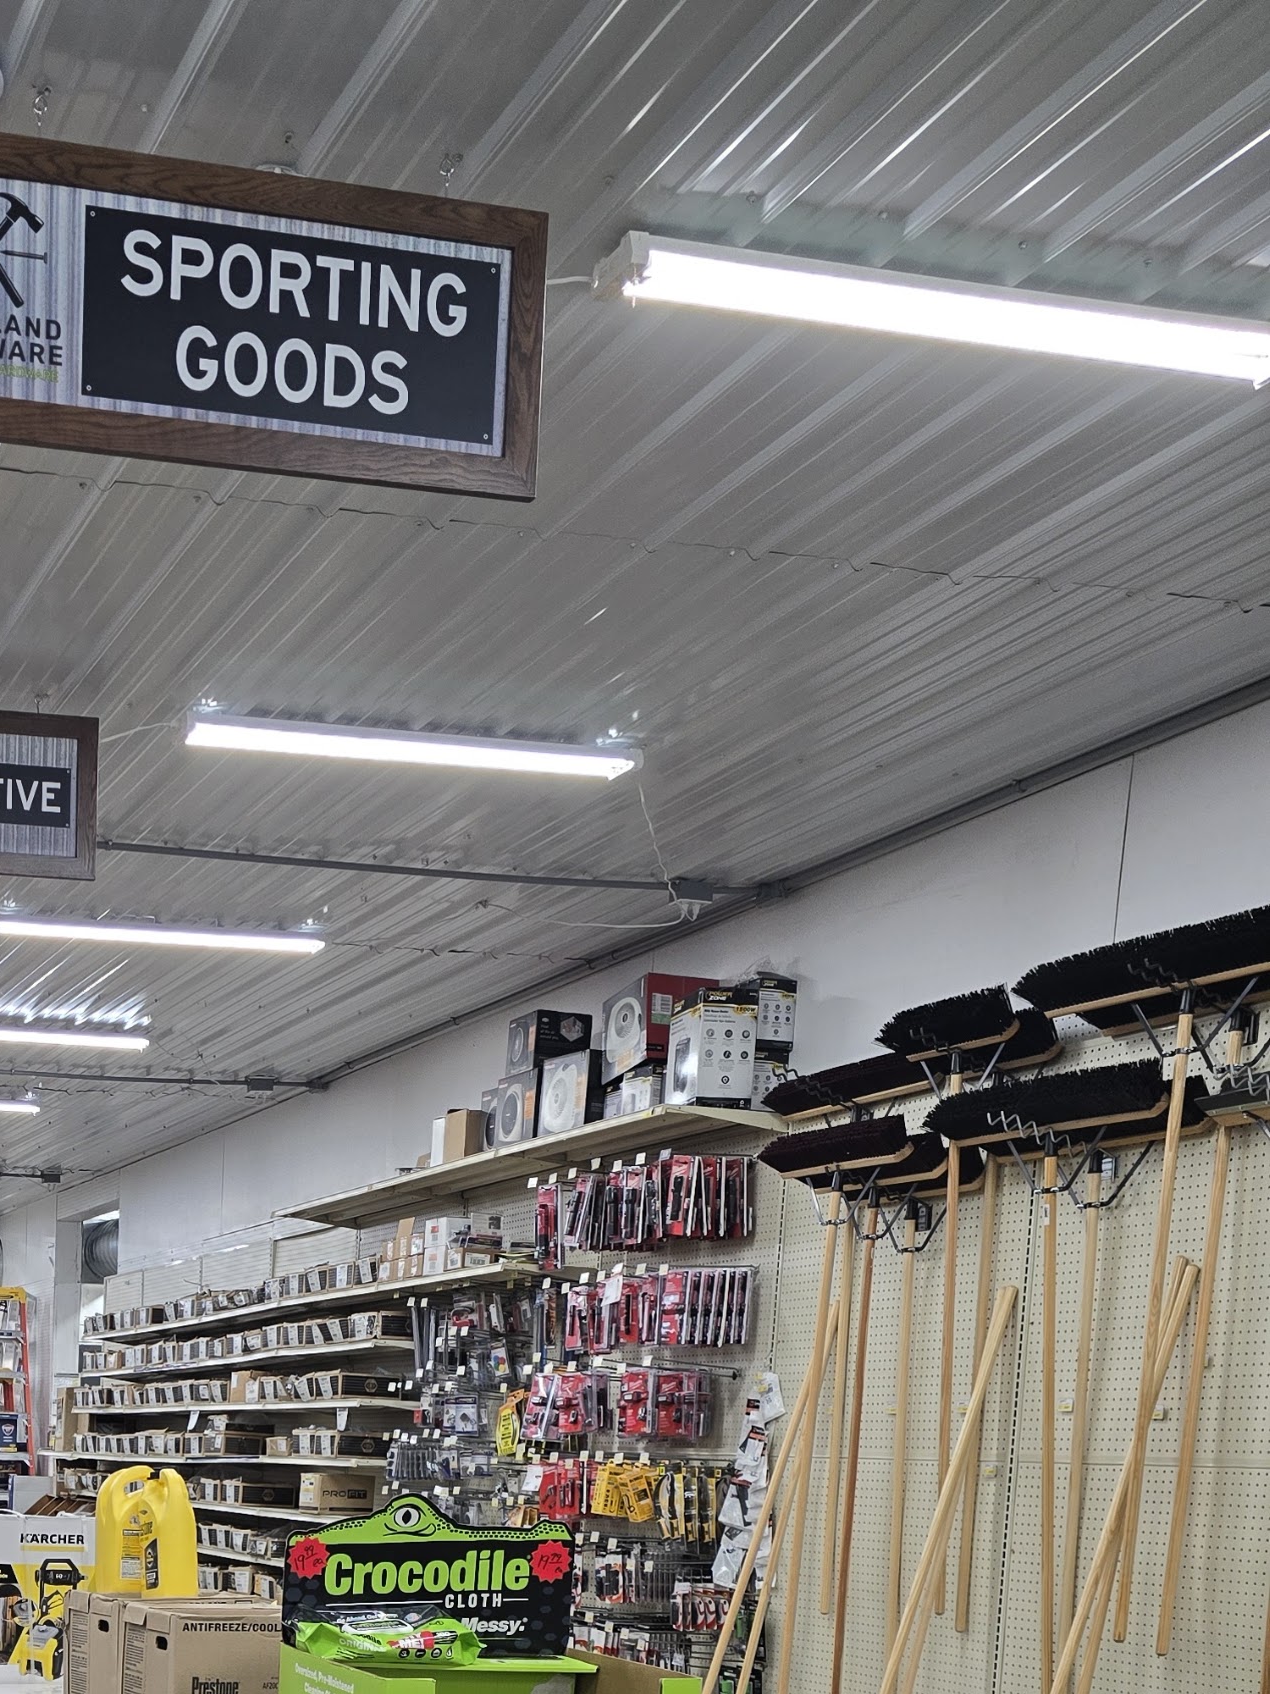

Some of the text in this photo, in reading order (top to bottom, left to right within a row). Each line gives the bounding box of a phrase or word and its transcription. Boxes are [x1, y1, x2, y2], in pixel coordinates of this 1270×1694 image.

[120, 229, 468, 338] SPORTING
[175, 324, 410, 415] GOODS
[20, 1533, 85, 1545] KÄRCHER
[324, 1549, 530, 1596] Crocodile
[444, 1593, 503, 1609] CLOTH
[182, 1622, 282, 1632] ANTIFREEZE/COOL
[460, 1616, 526, 1635] Messy.
